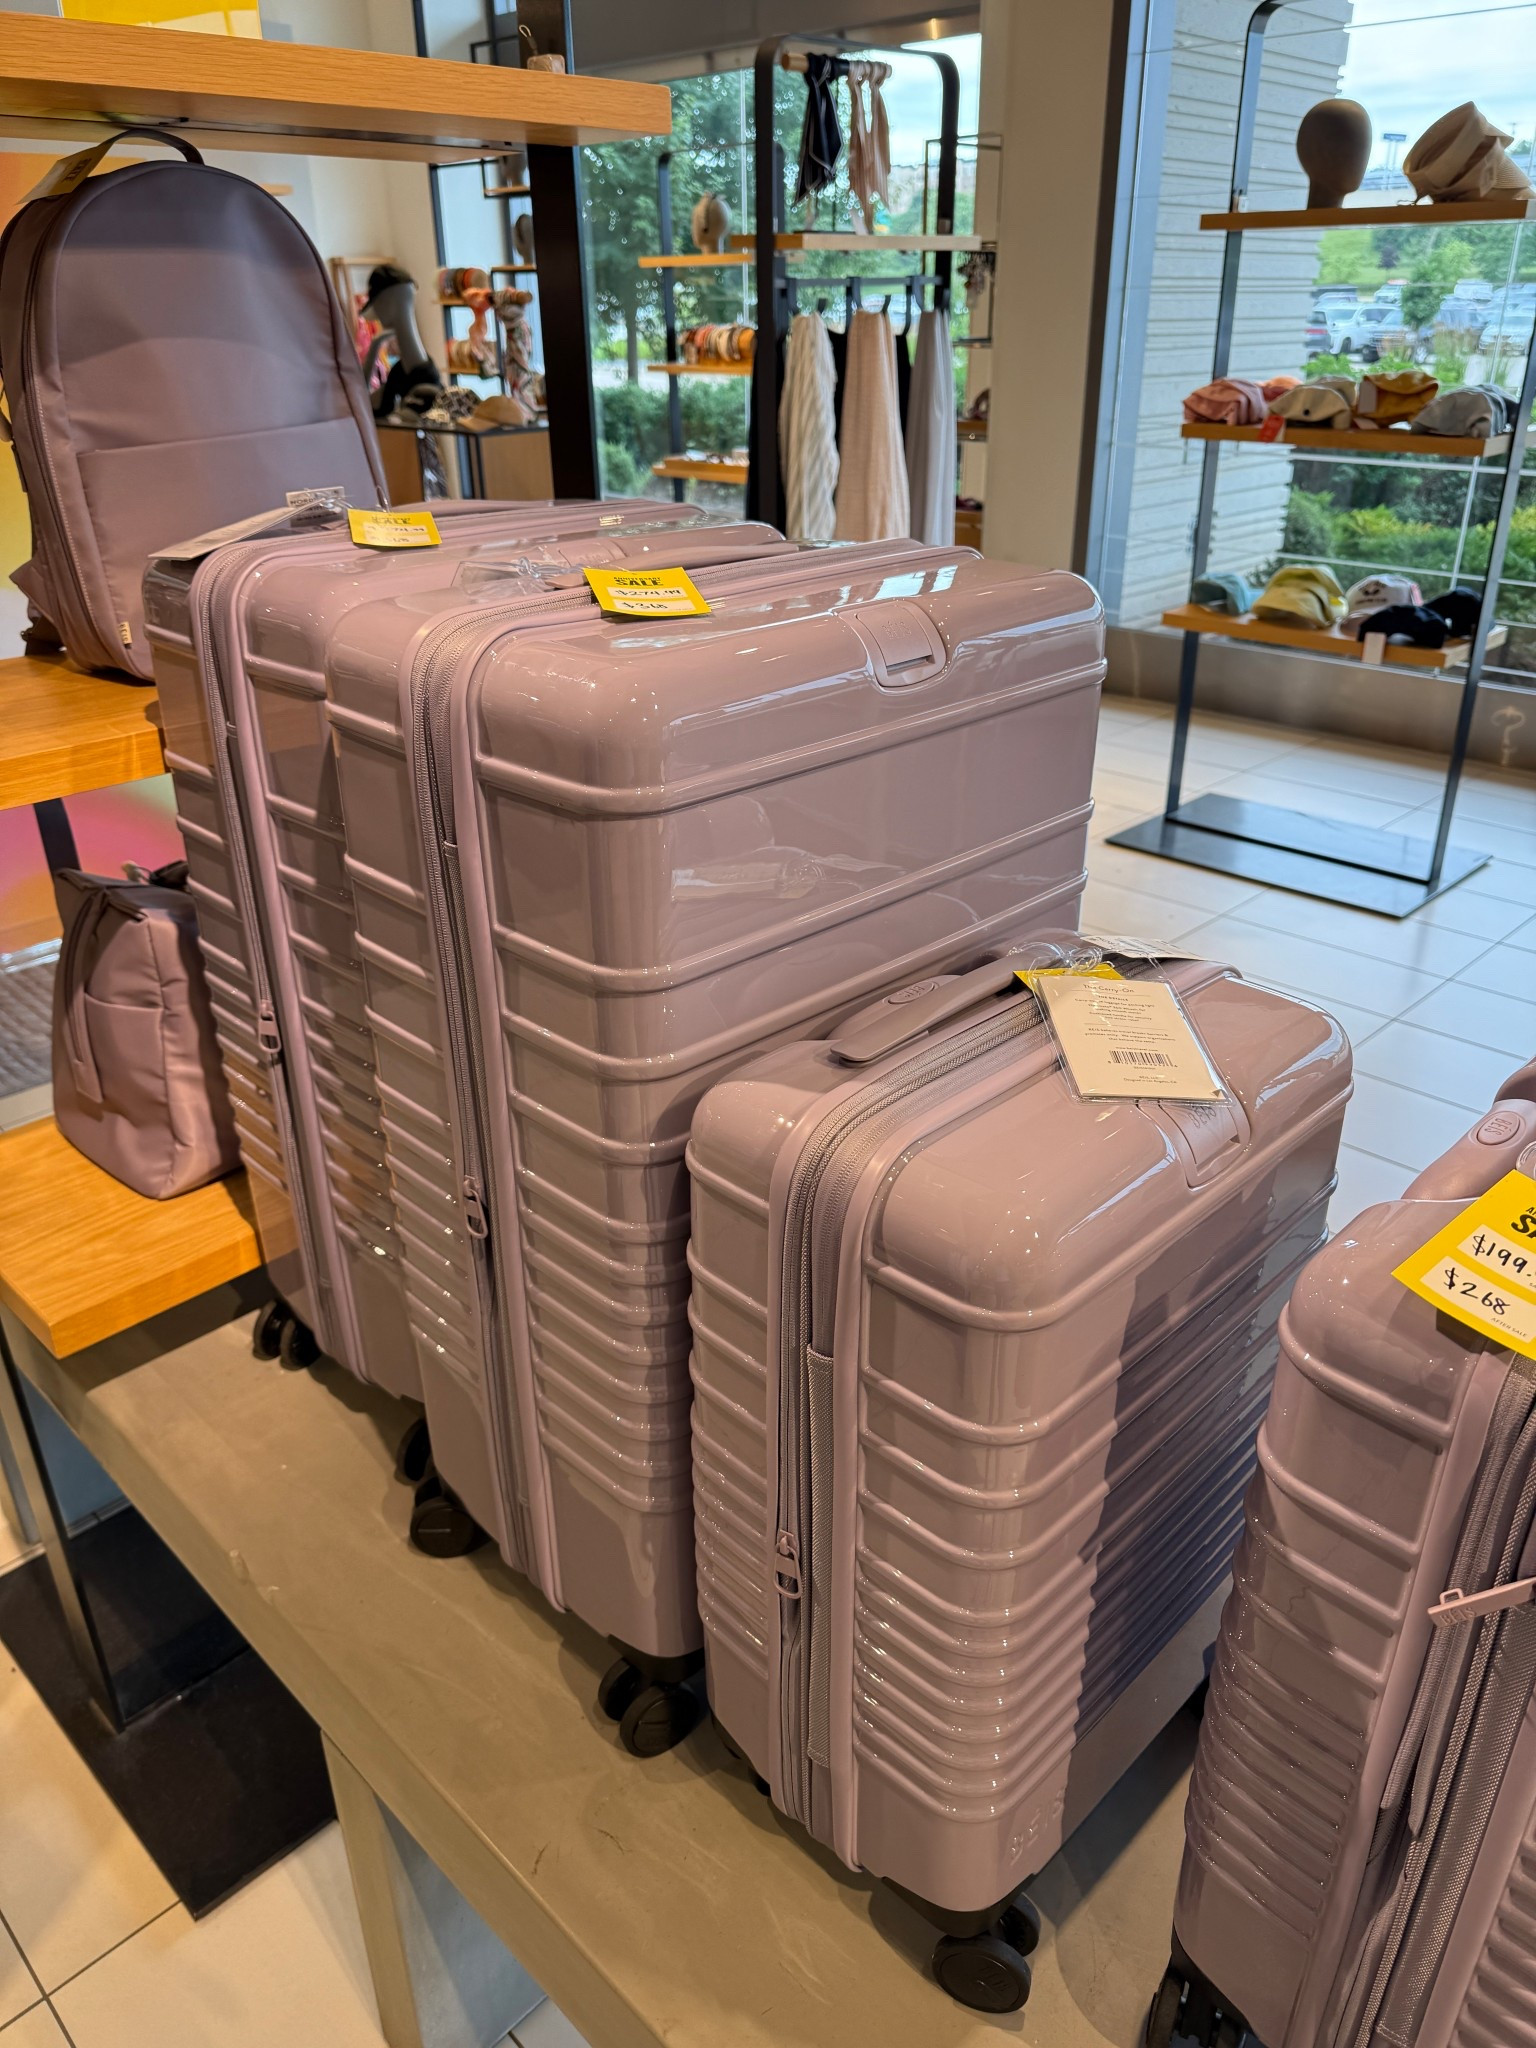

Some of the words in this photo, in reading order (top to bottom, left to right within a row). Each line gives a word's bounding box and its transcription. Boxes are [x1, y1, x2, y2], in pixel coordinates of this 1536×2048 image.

[1098, 985, 1135, 993] Carry-On
[1443, 1267, 1511, 1316] $268
[1490, 1317, 1511, 1330] AFTER
[1512, 1328, 1528, 1338] SALE
